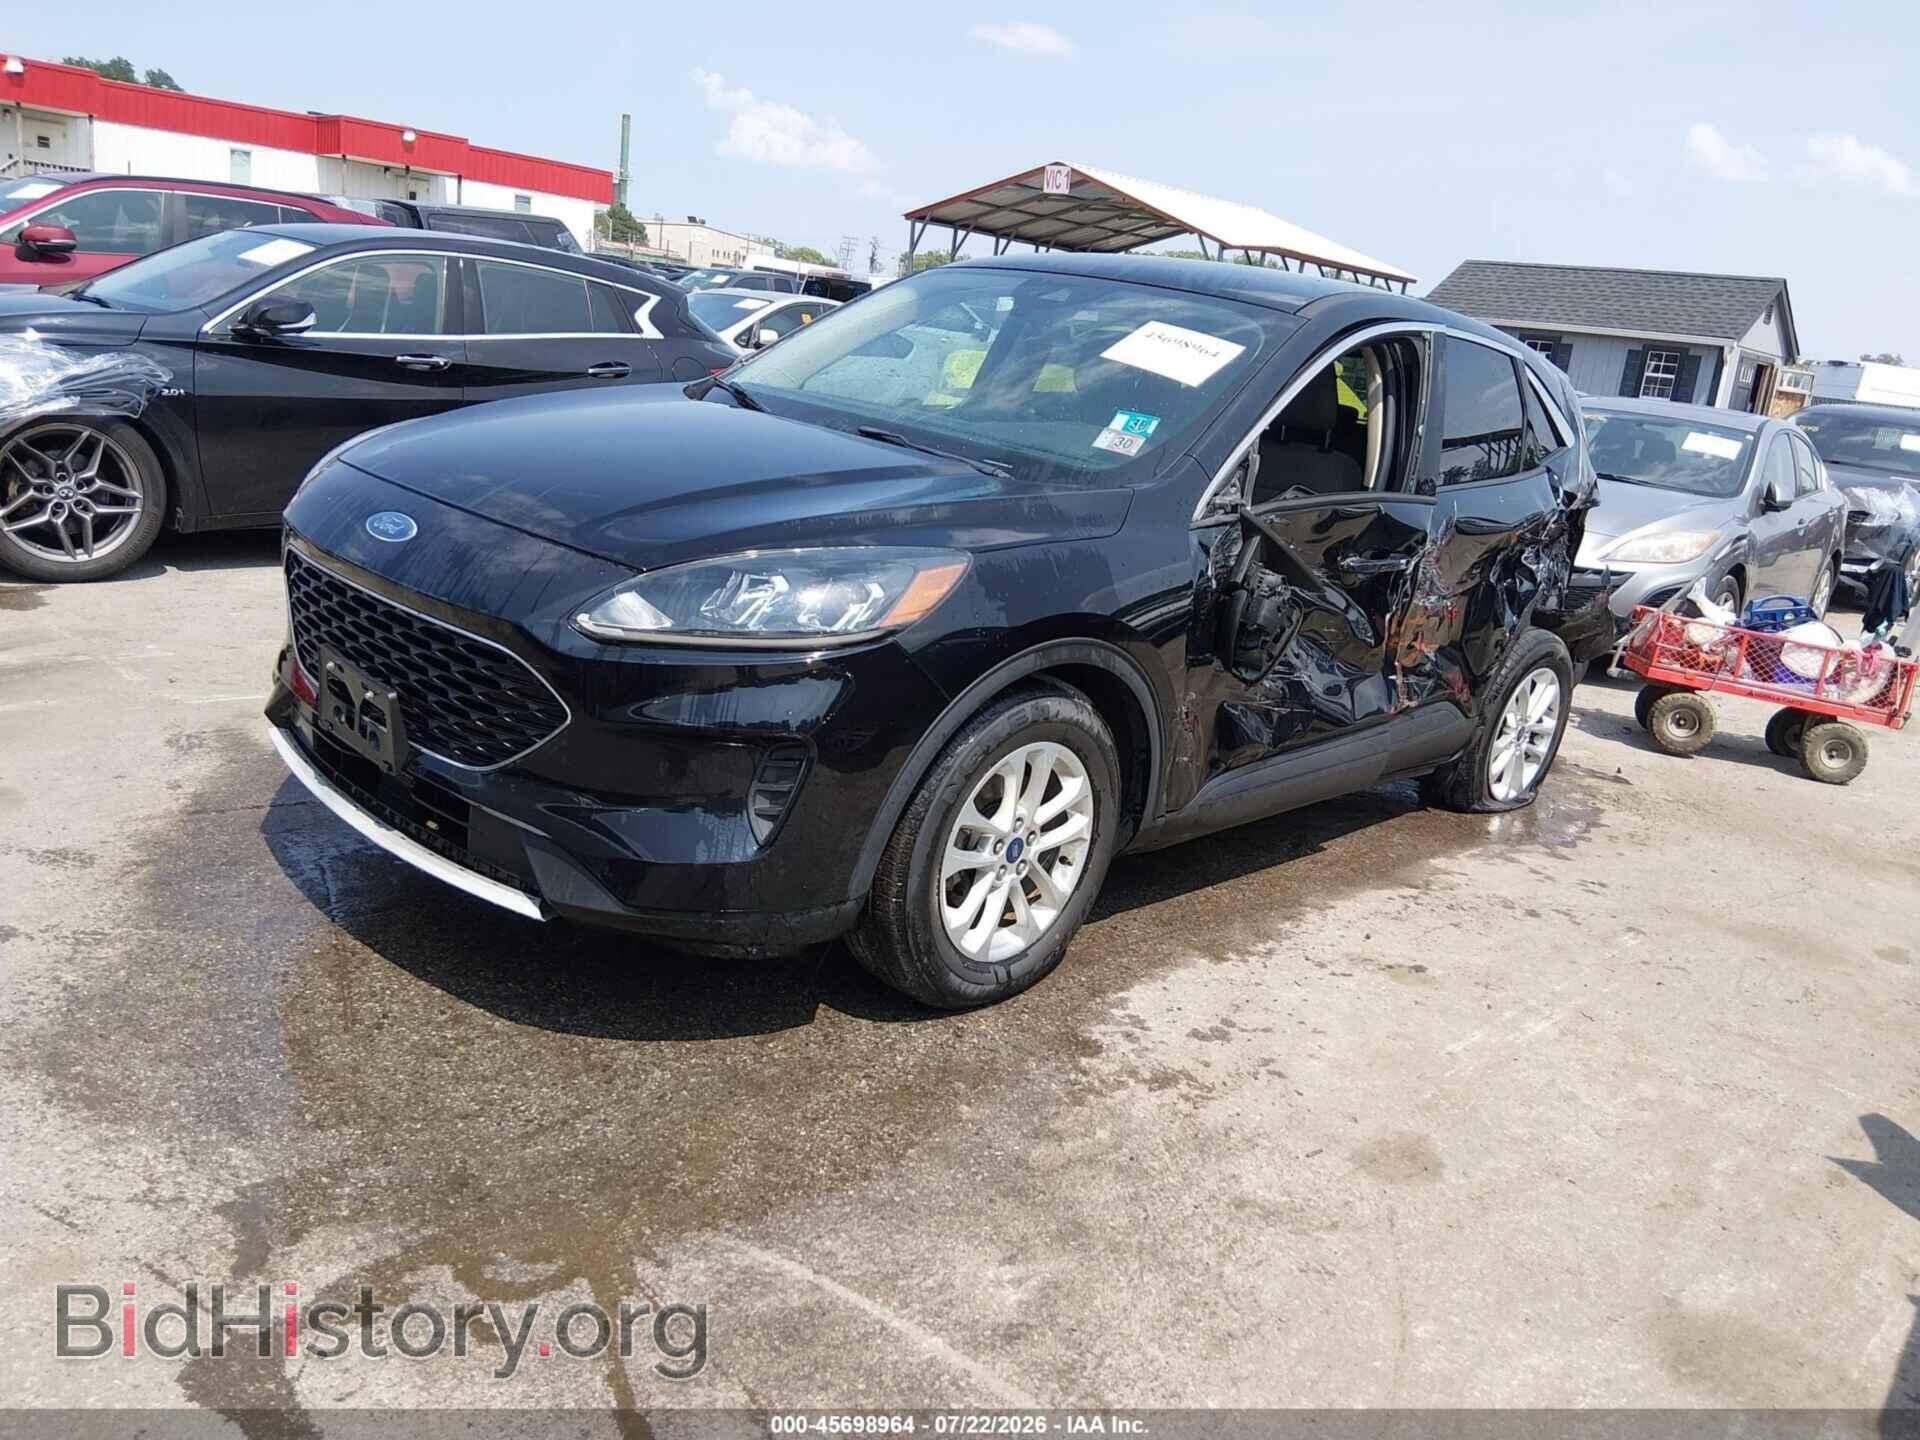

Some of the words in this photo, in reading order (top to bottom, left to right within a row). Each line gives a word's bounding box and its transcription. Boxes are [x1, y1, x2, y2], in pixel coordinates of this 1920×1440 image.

[1045, 169, 1062, 190] VIC
[1063, 170, 1070, 190] 1
[1113, 437, 1134, 449] 30
